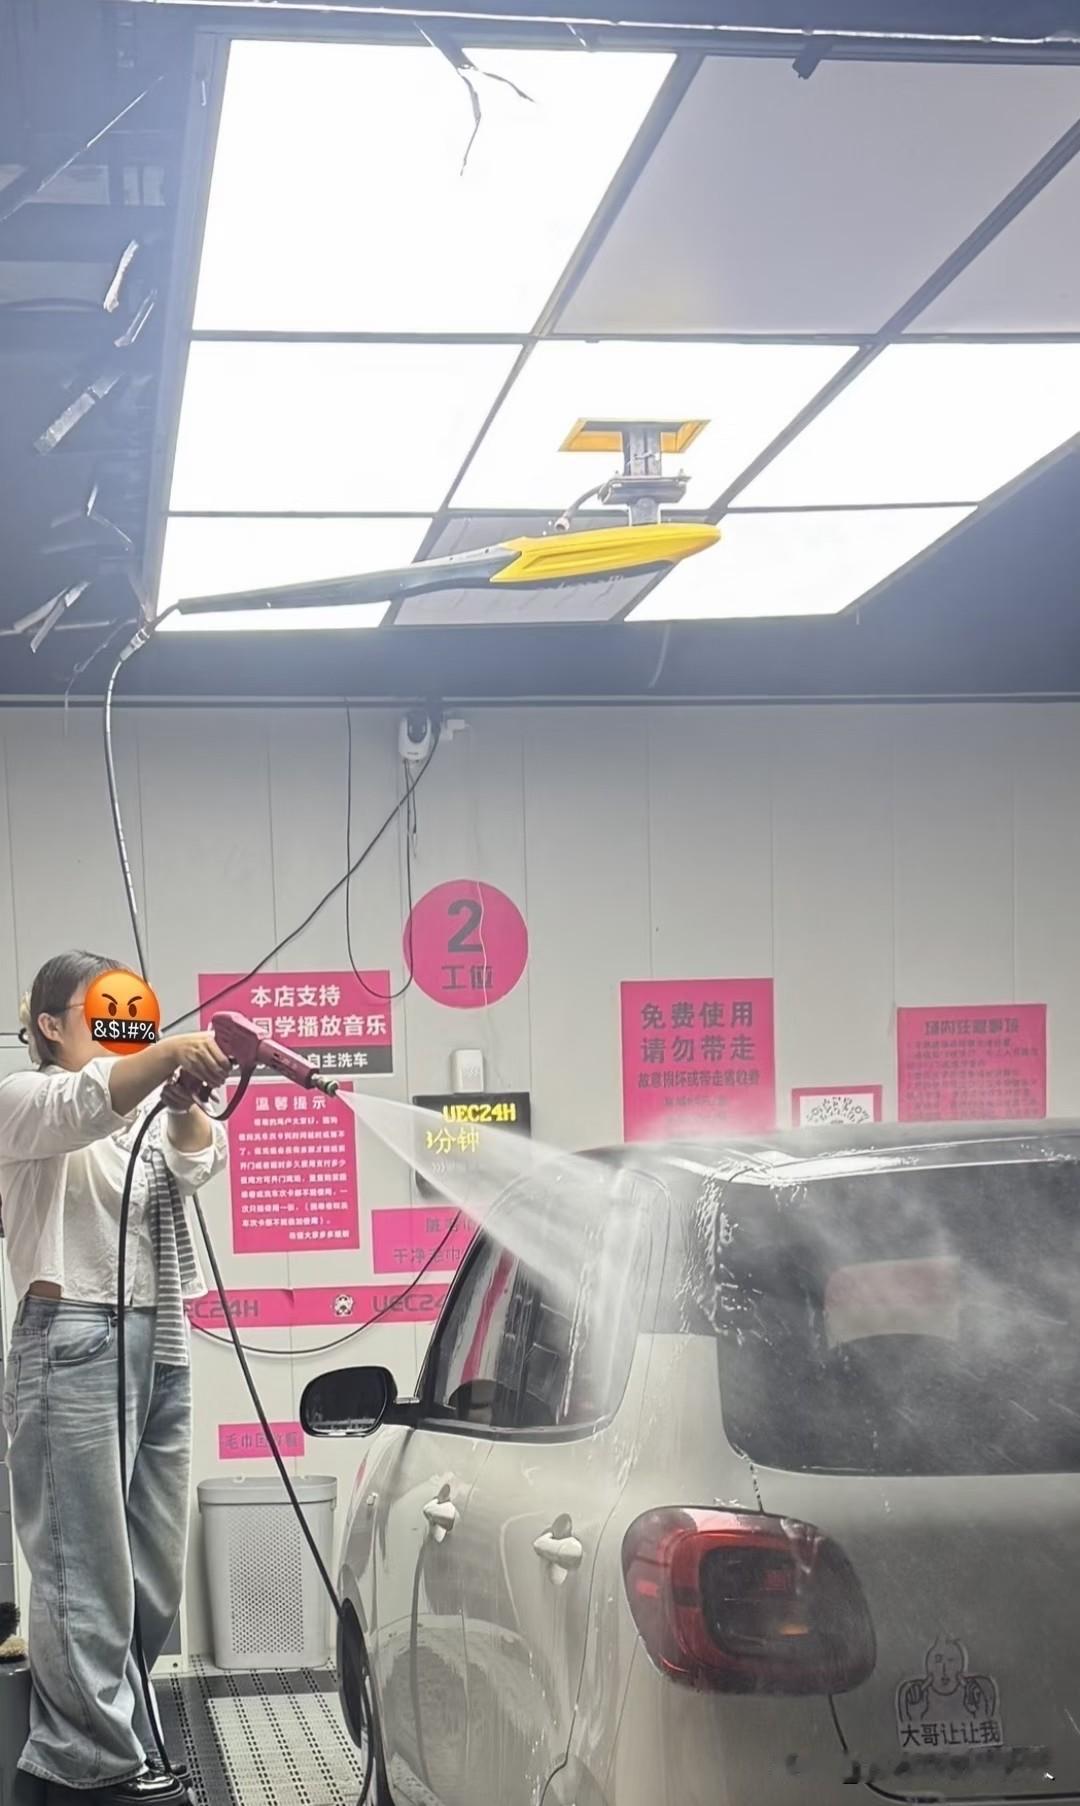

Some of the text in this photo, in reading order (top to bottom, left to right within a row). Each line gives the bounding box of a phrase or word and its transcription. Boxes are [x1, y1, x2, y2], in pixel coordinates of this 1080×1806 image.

[447, 898, 483, 953] 2
[441, 964, 493, 990] 工位
[251, 984, 341, 1008] 本店支持
[640, 1001, 754, 1030] 免费使用
[640, 1034, 755, 1064] 请勿带走
[256, 1096, 326, 1111] 温馨提示
[442, 1102, 517, 1123] UEC24H
[901, 1719, 1001, 1747] 大哥让让我
